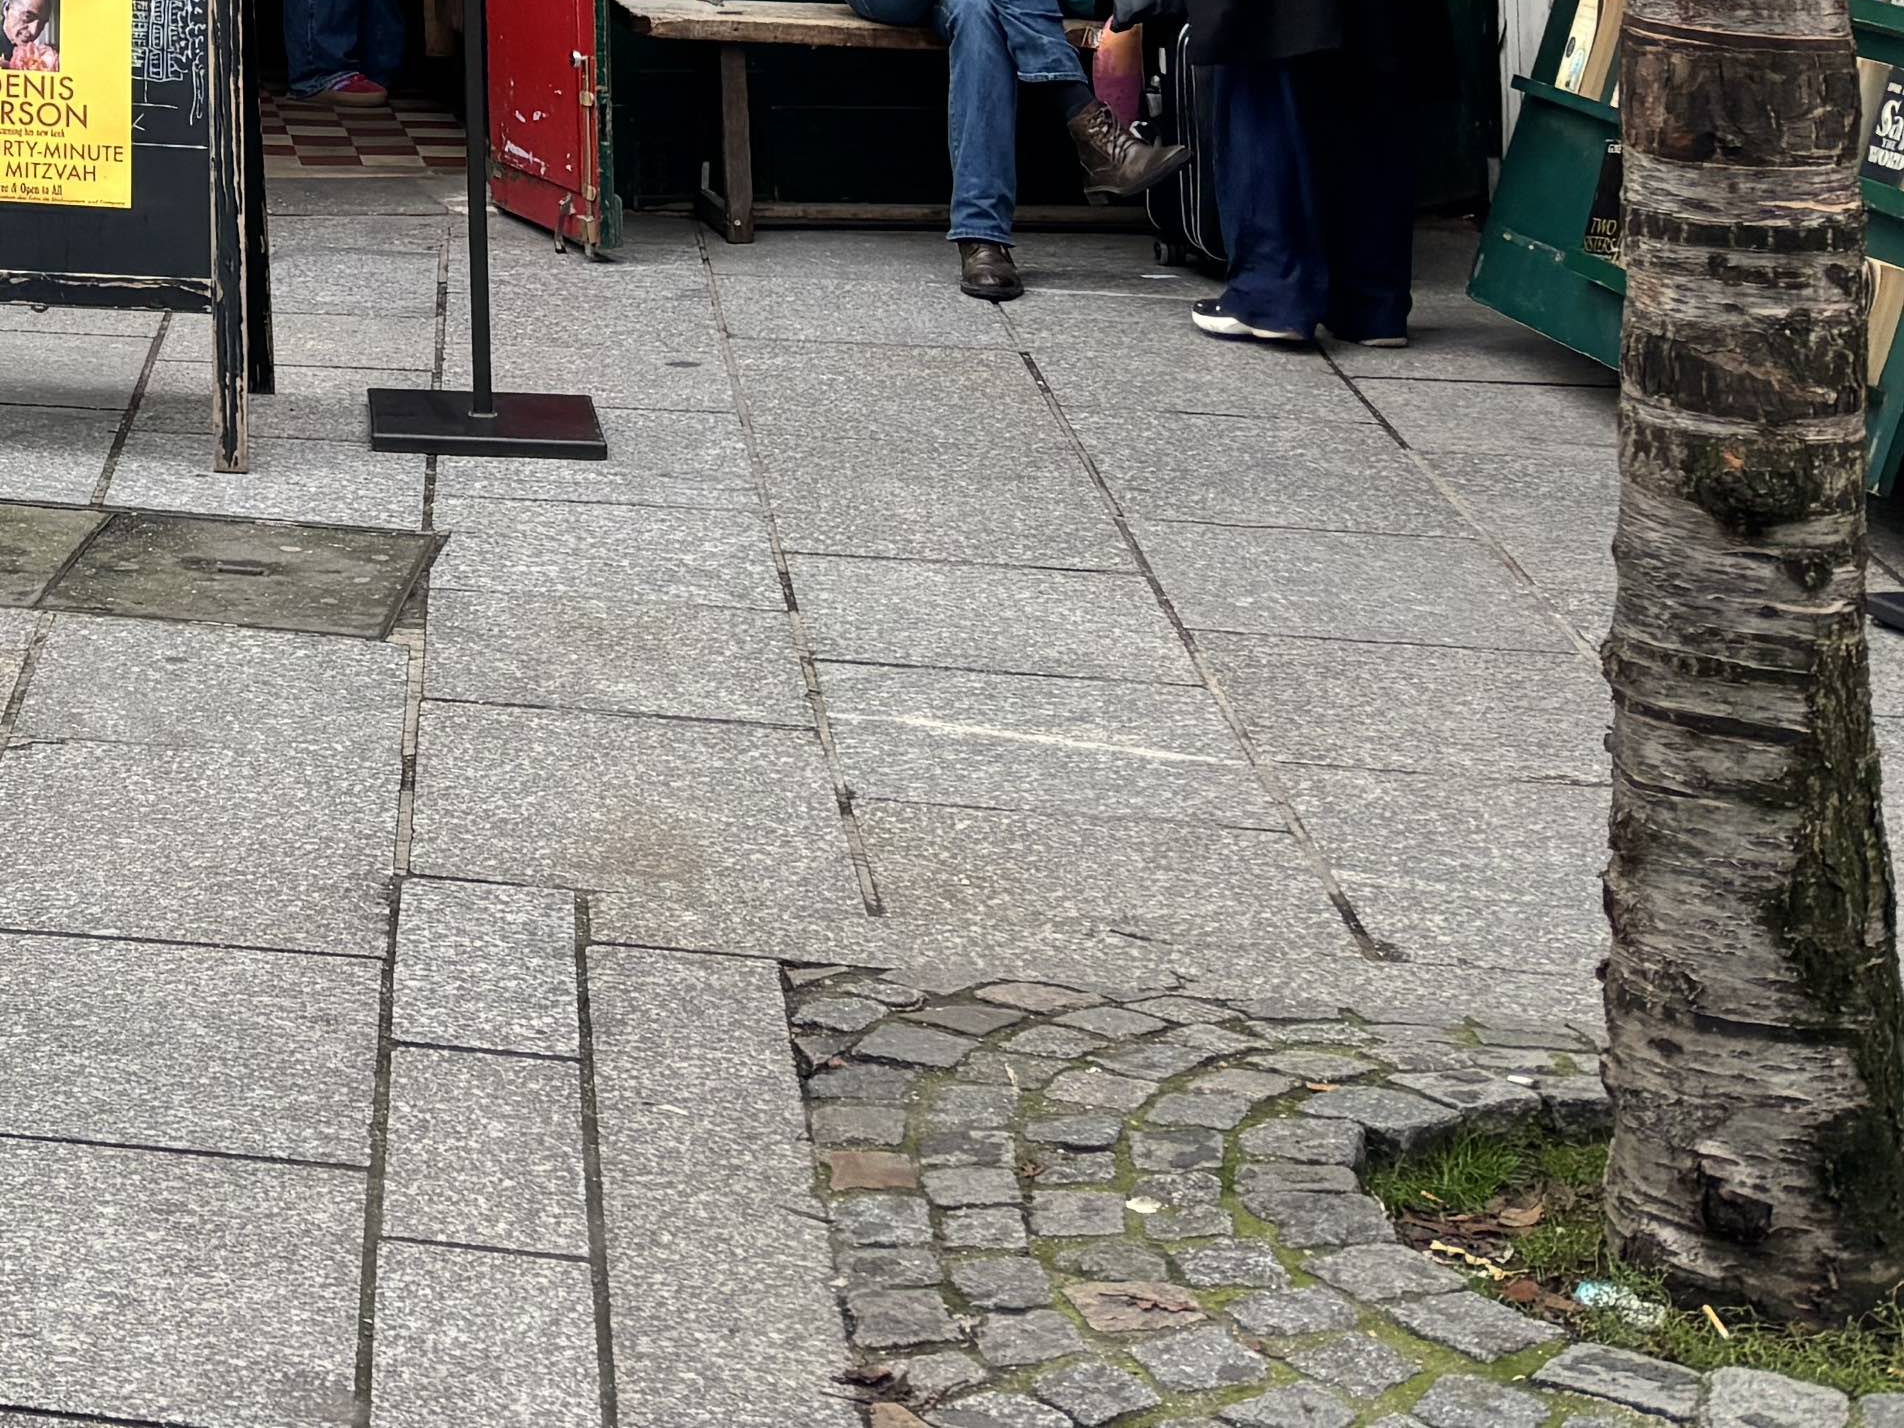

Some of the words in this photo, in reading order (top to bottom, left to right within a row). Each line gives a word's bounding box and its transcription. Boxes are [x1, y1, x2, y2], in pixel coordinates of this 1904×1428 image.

[6, 161, 96, 181] MITZVAH
[20, 183, 39, 195] Open
[52, 185, 63, 195] All
